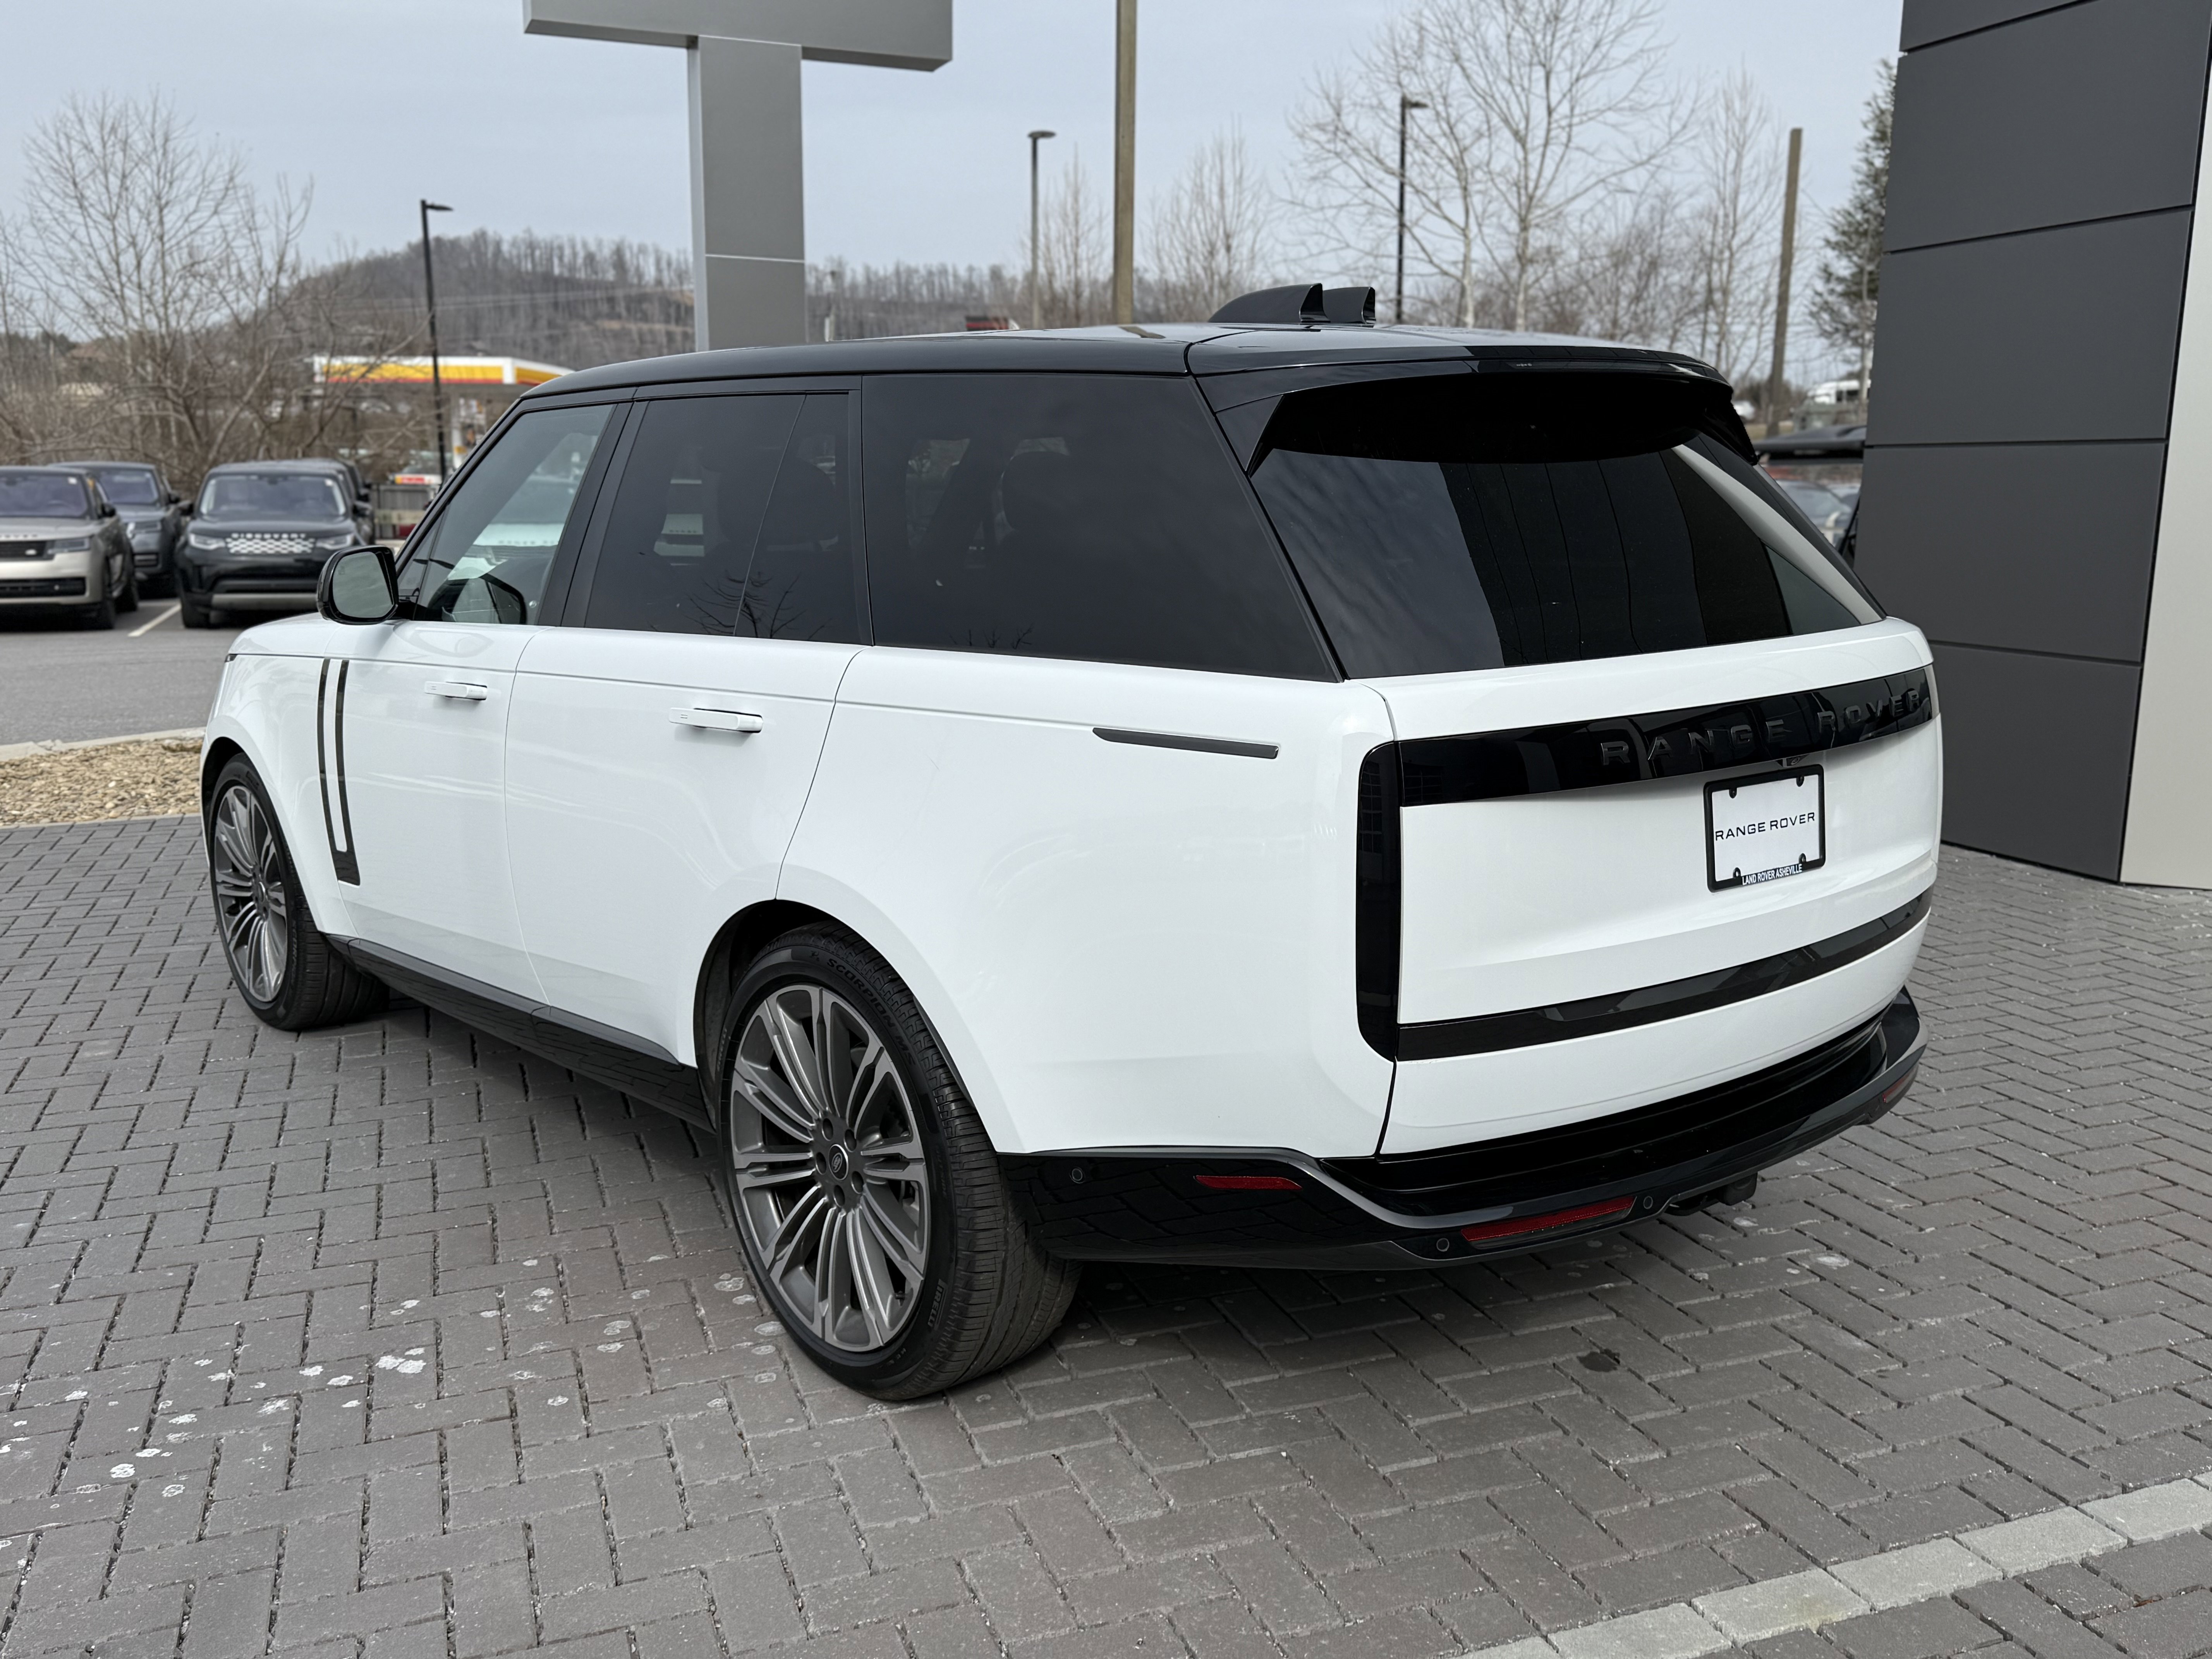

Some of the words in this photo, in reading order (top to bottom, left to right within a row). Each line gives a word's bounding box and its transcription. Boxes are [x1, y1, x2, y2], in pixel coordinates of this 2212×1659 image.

[1600, 719, 1786, 766] RANGE
[1817, 688, 1920, 734] ROVER
[1715, 822, 1766, 841] RANGE
[1770, 812, 1815, 830] ROVER
[1742, 874, 1757, 885] LAND
[1757, 870, 1775, 881] ROVER
[1776, 864, 1802, 878] ASHEVILLE
[827, 958, 895, 1027] SCORPION
